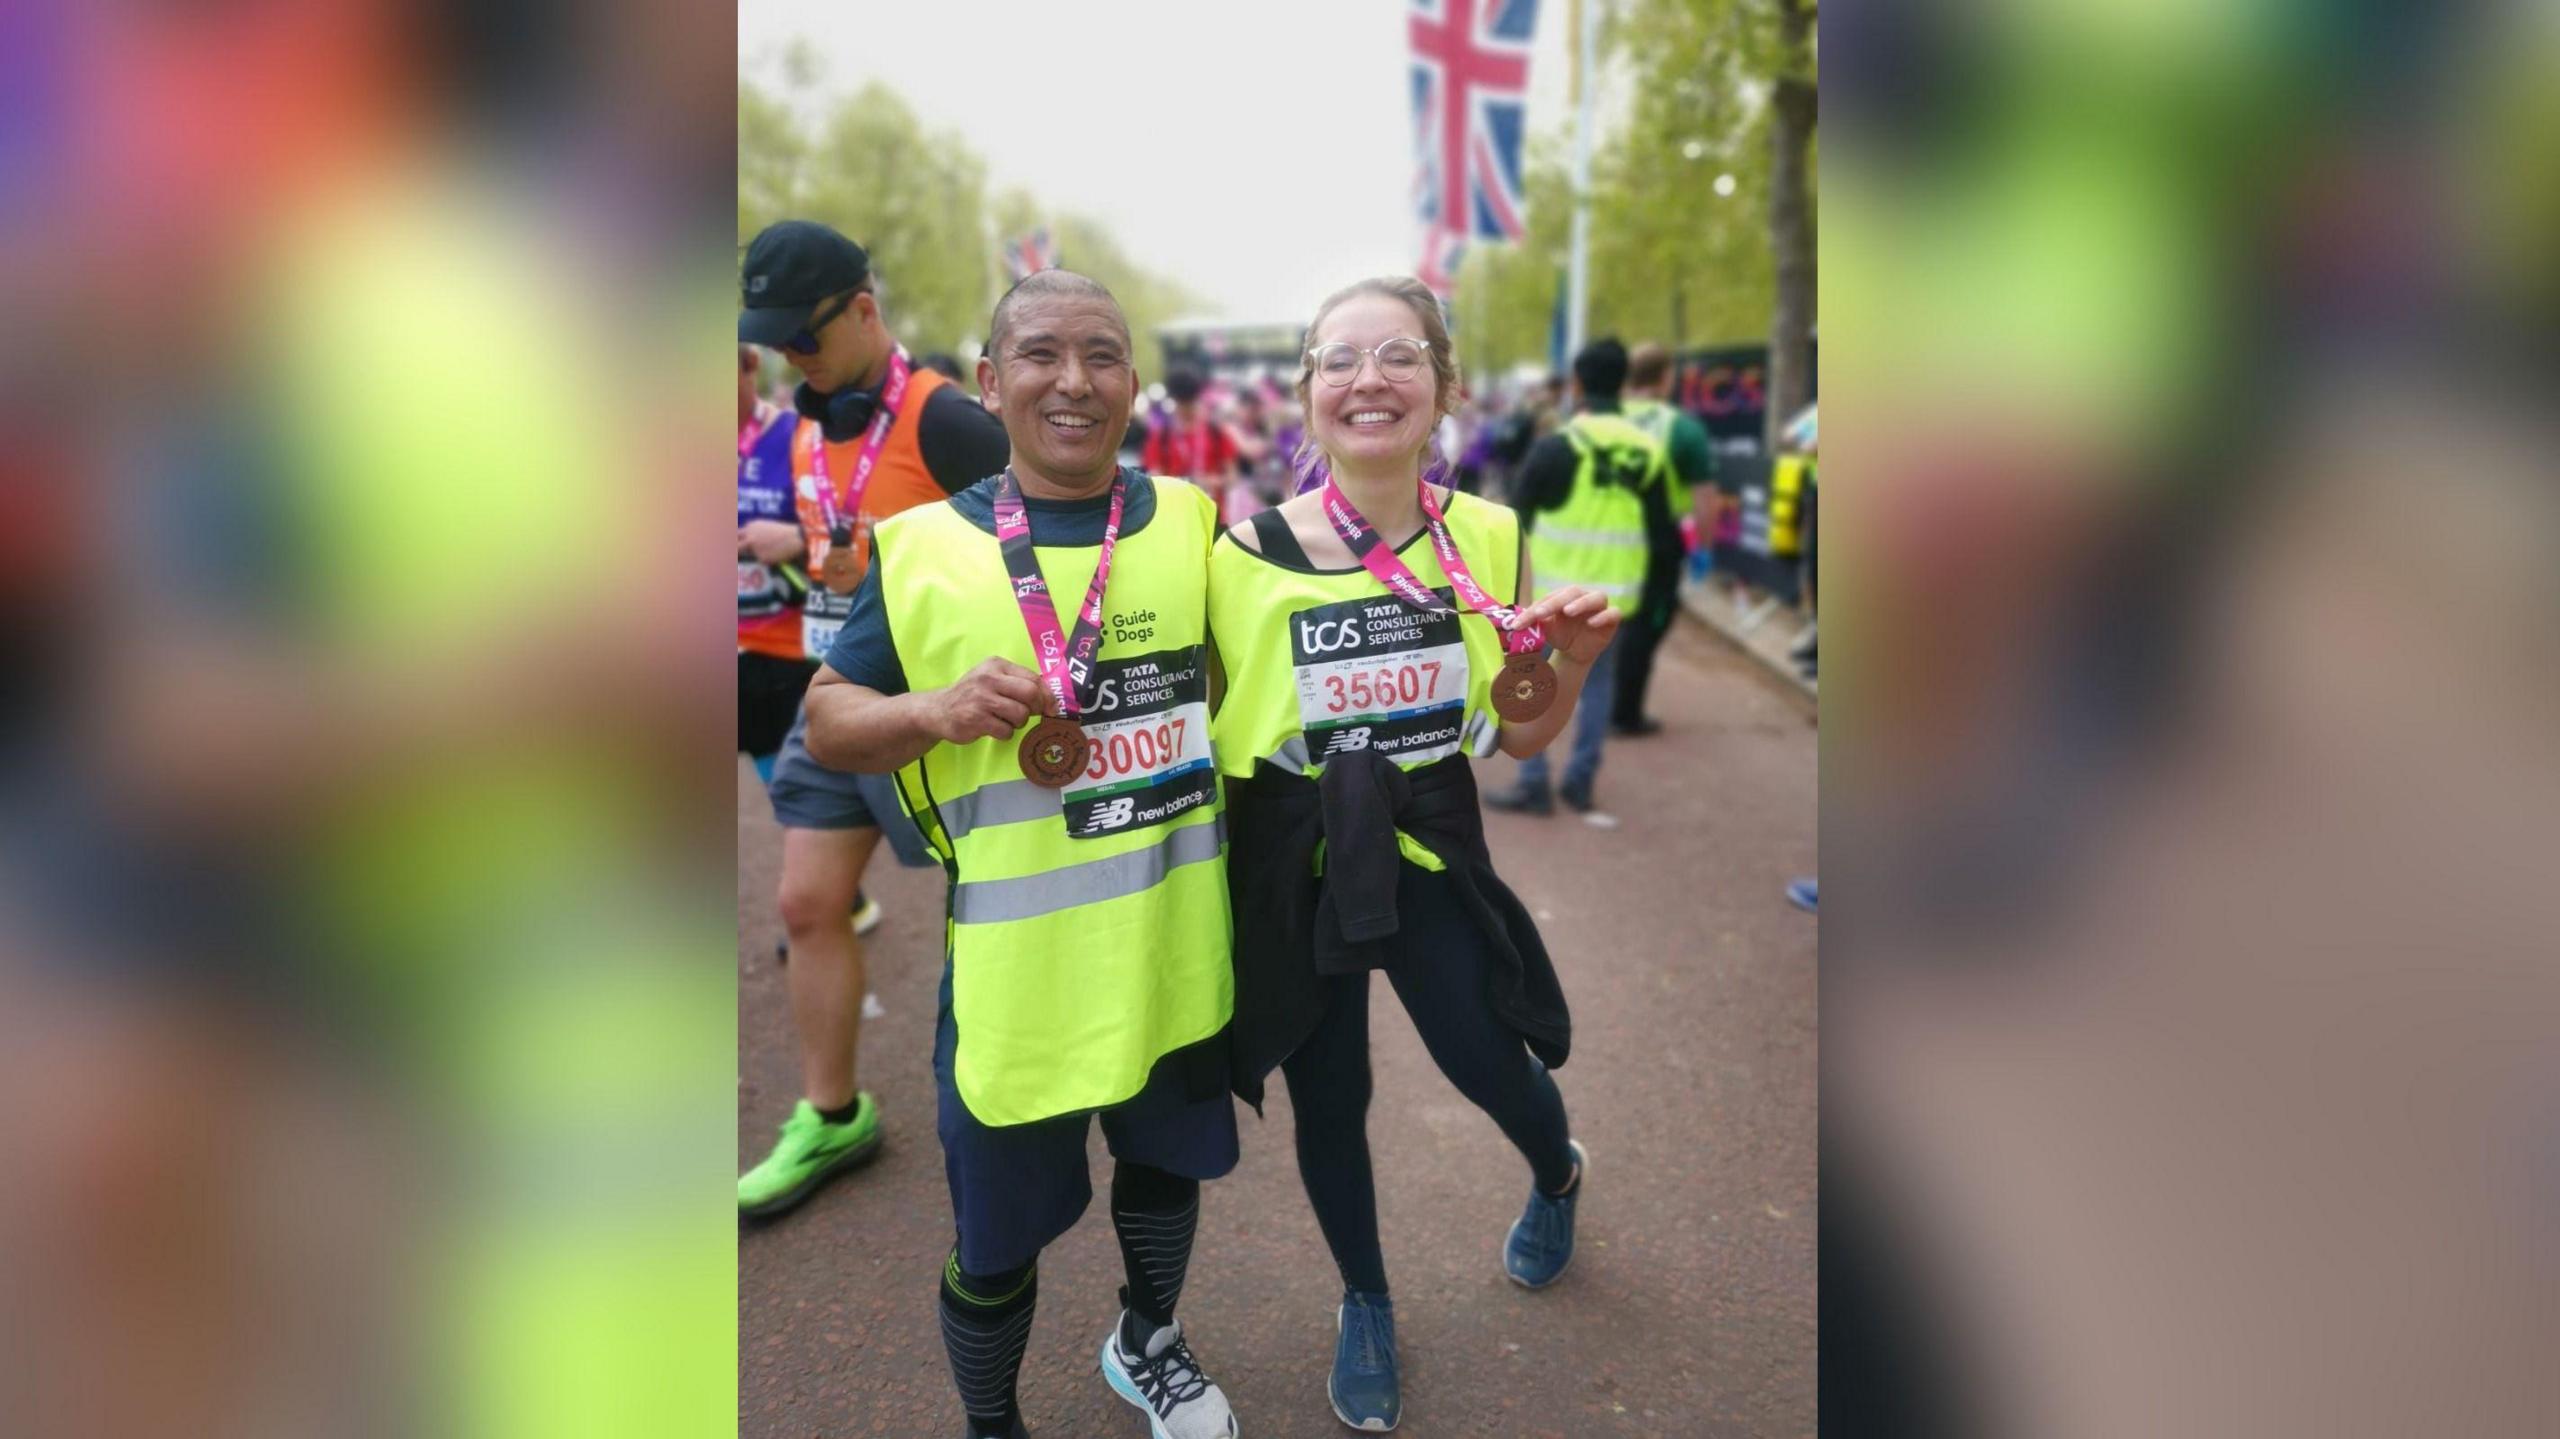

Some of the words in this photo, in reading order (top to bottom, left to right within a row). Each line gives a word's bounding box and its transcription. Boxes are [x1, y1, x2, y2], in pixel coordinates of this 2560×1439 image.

[1330, 499, 1362, 540] FINISHER
[1391, 572, 1430, 604] FINISHER
[1112, 609, 1156, 628] Guide
[1364, 603, 1402, 619] TATA
[1366, 611, 1447, 633] CONSULTANCY
[1040, 630, 1059, 656] tcs
[1116, 627, 1154, 642] Dogs
[1301, 618, 1361, 655] tcs
[1368, 628, 1424, 646] SERVICES
[1076, 636, 1096, 659] tcs
[1122, 663, 1159, 678] TATA
[1124, 668, 1196, 692] CONSULTANCY
[1047, 676, 1068, 718] FINISH
[1126, 687, 1174, 707] SERVICES
[1325, 661, 1442, 713] 35607
[1087, 718, 1185, 780] 30097
[1373, 737, 1400, 751] new
[1137, 807, 1164, 822] new
